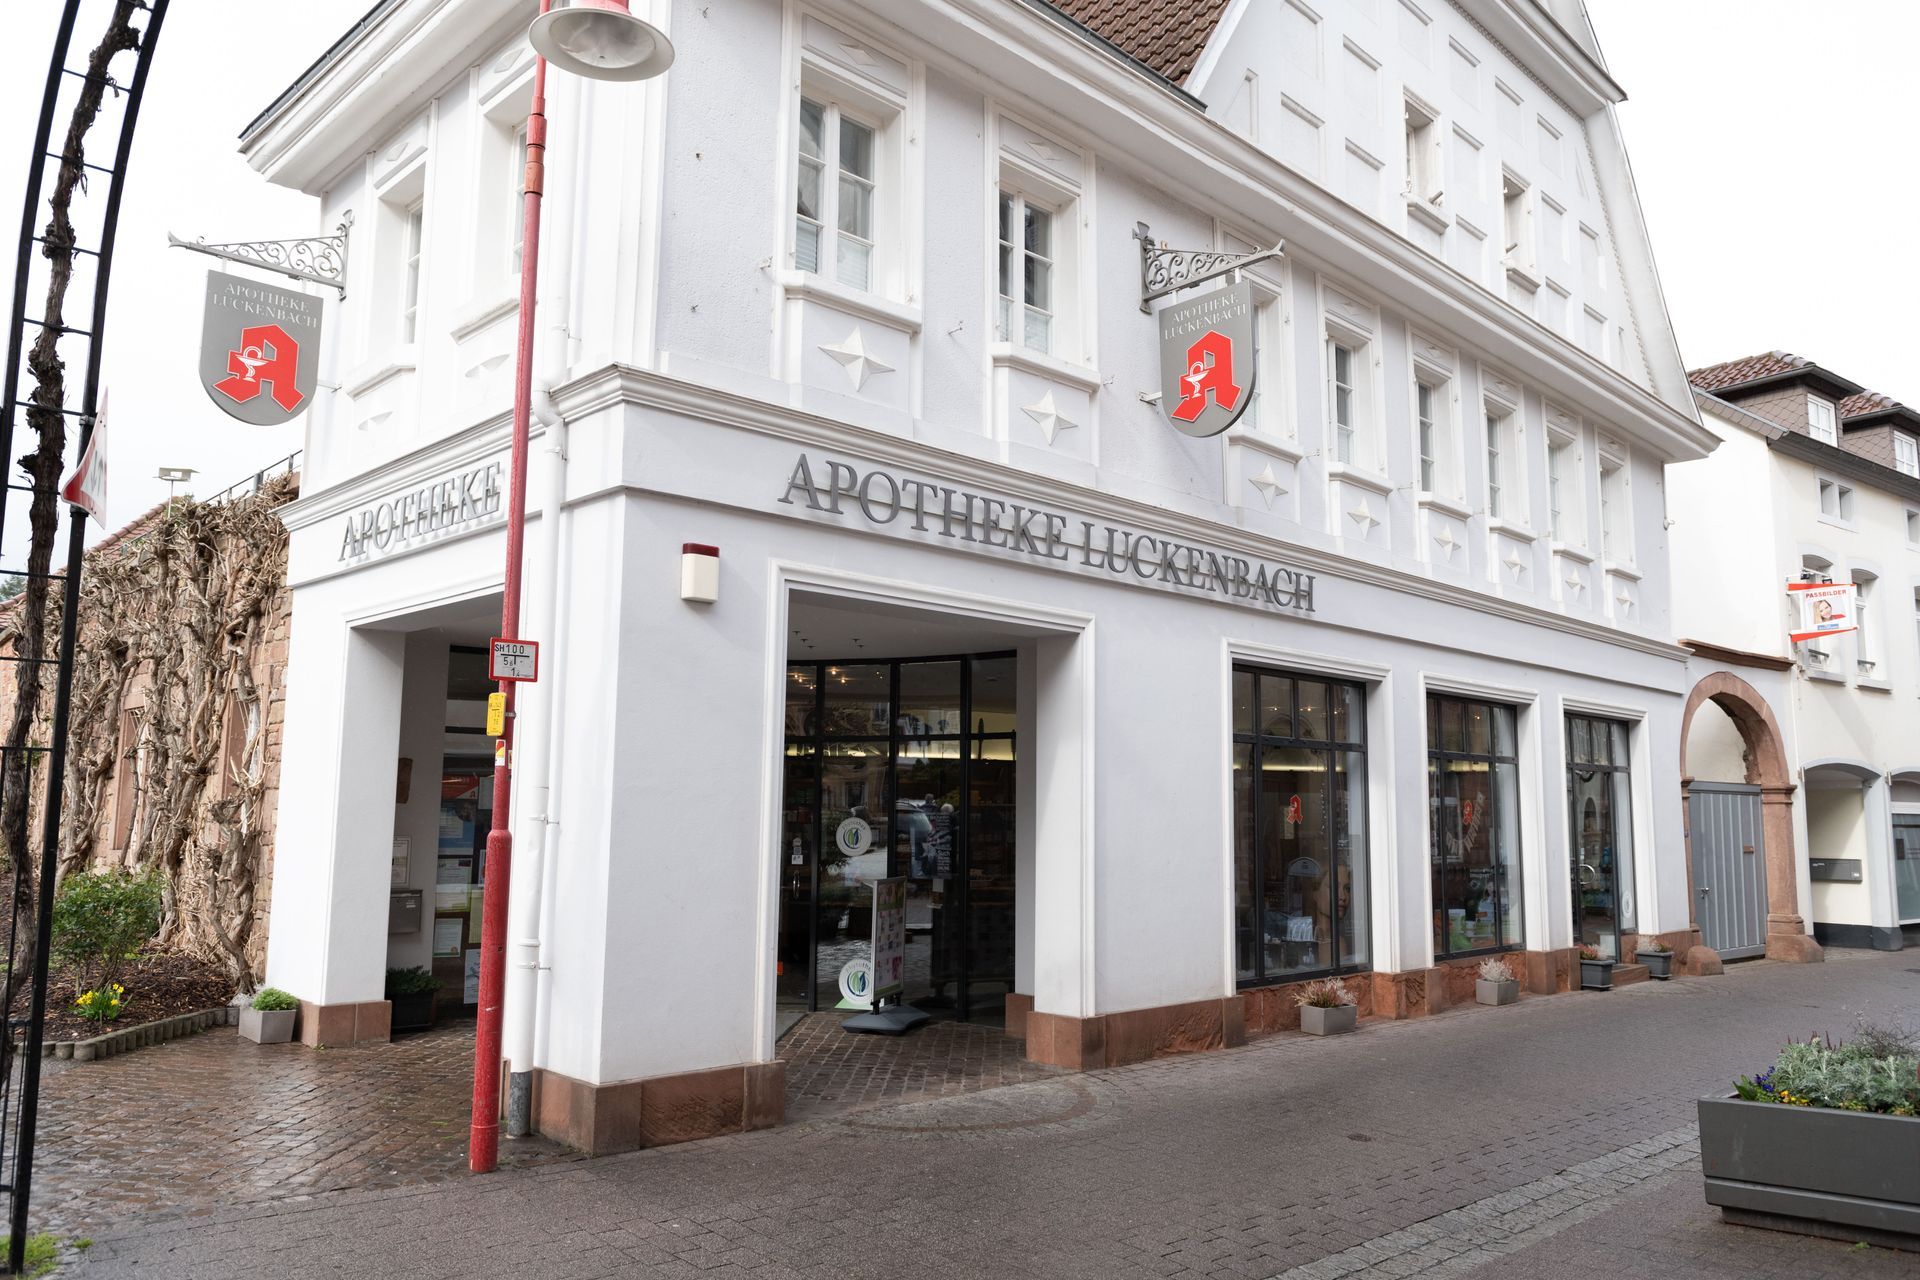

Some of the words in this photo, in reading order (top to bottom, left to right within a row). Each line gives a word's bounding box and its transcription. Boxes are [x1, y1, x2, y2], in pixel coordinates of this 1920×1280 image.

[213, 293, 318, 328] LUCKENBACH
[224, 282, 309, 312] APOTHEKE
[1172, 293, 1239, 323] APOTHEKE
[1164, 304, 1247, 340] LUCKENBACH
[338, 461, 501, 561] APOTHEKE
[777, 452, 1069, 561] APOTHEKE
[1080, 520, 1316, 613] LUCKENBACH
[1806, 590, 1846, 598] PASSBILDER
